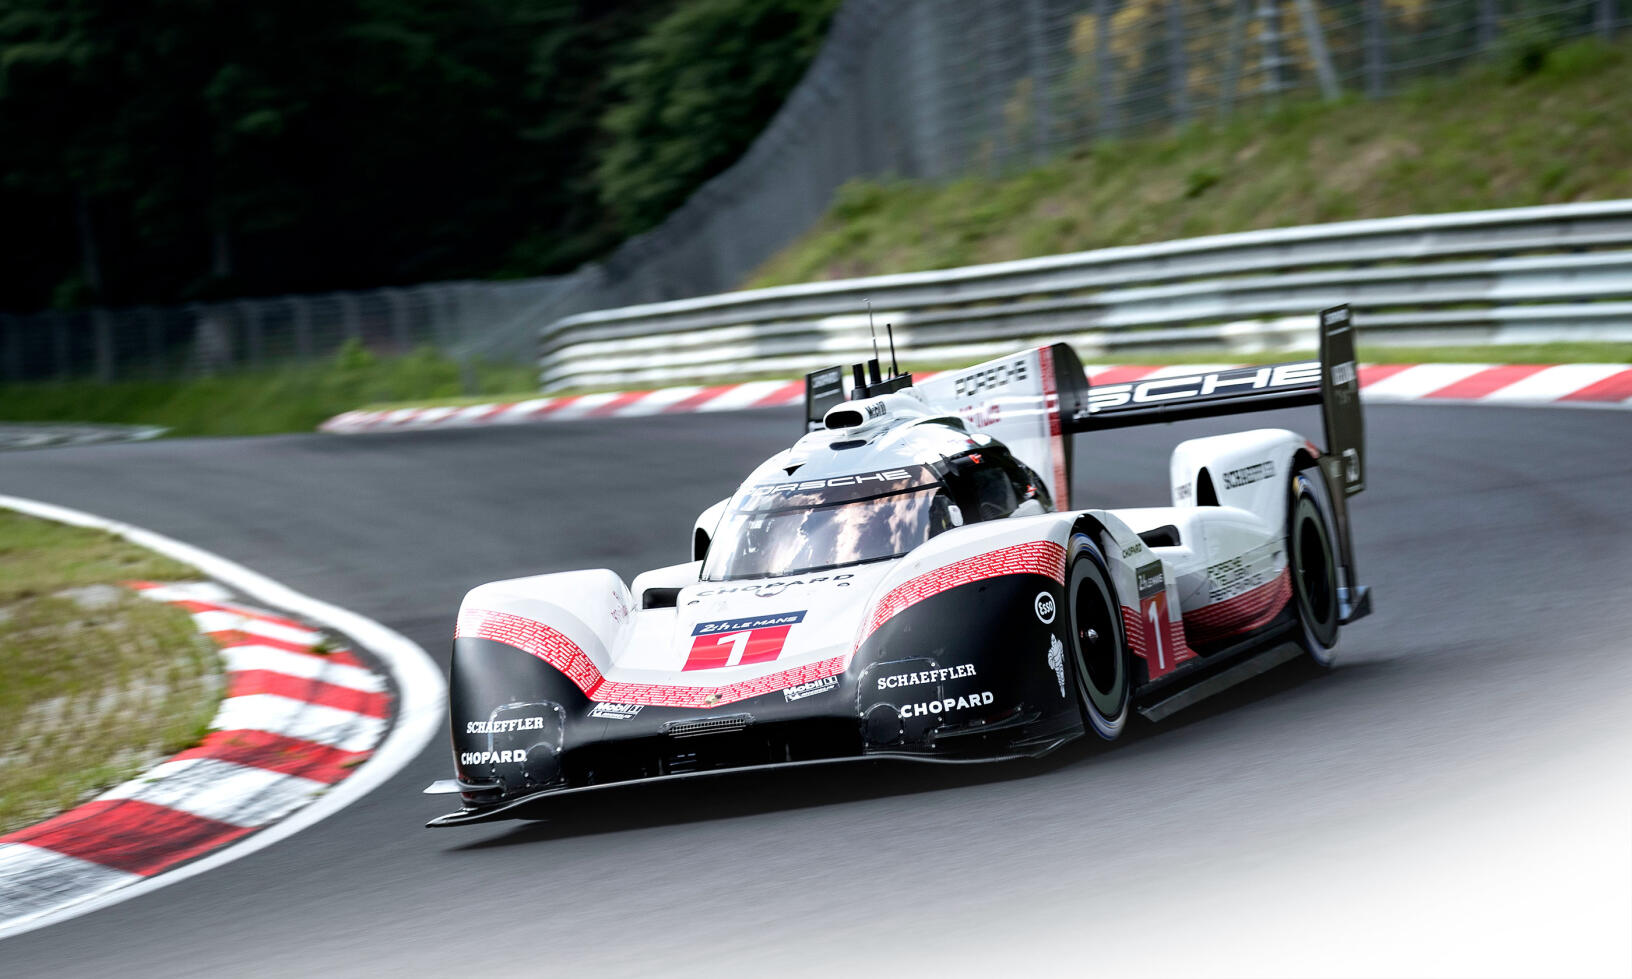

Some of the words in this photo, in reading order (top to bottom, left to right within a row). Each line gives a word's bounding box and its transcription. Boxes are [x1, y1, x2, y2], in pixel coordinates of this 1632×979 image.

[954, 360, 1027, 399] PORSCHE
[750, 468, 913, 497] ORSCHE
[697, 574, 855, 597] CHOPARD
[1038, 600, 1054, 615] Esso
[753, 616, 799, 627] MANS
[1148, 600, 1165, 669] 1
[717, 630, 752, 667] 1
[783, 679, 823, 696] Mobil
[876, 663, 977, 690] SCHAEFFLER
[593, 702, 633, 712] Mobil
[900, 691, 994, 718] CHOPARD
[466, 717, 544, 734] SCHAEFFLER
[461, 749, 527, 765] CHOPARD
